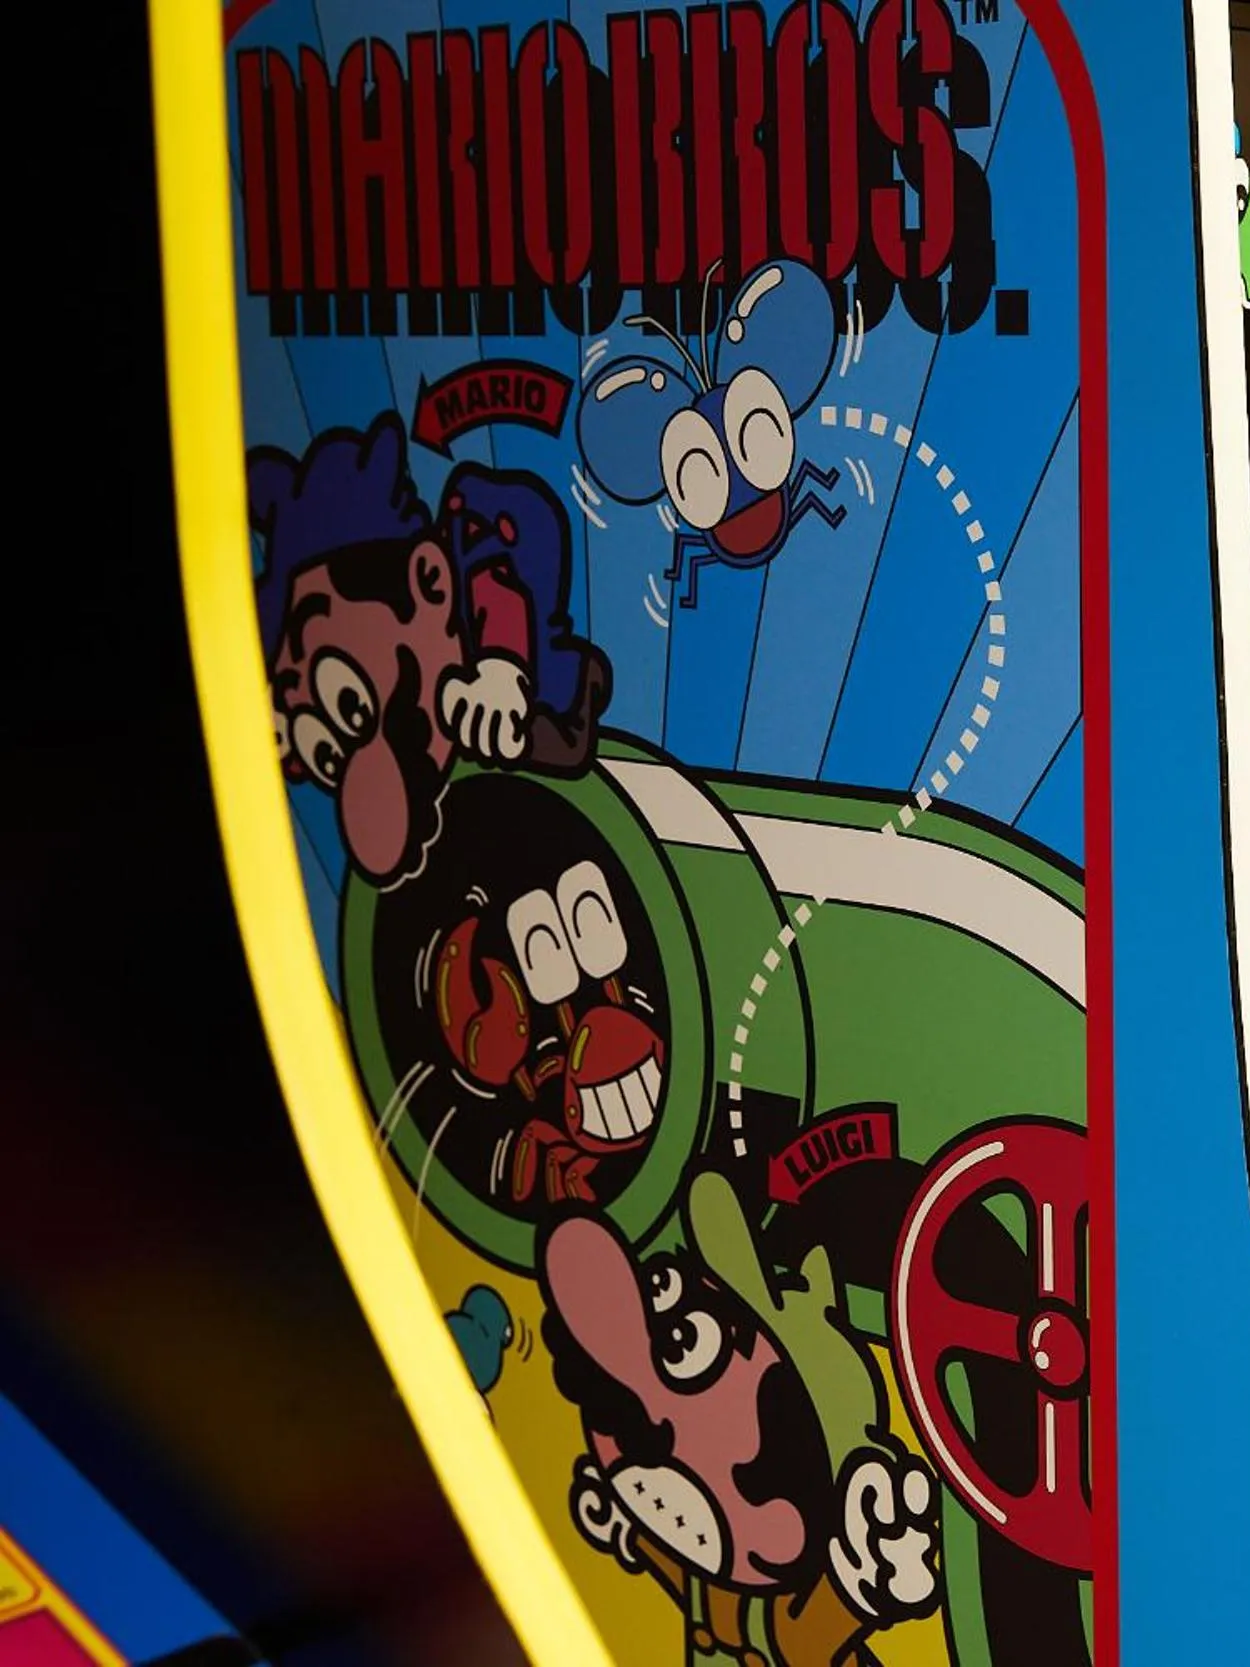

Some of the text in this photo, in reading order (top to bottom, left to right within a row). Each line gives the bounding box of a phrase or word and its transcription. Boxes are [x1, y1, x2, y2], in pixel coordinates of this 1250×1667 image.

[235, 18, 600, 296] MARIO
[434, 374, 547, 430] MARIO
[783, 1119, 876, 1186] LUIGI
